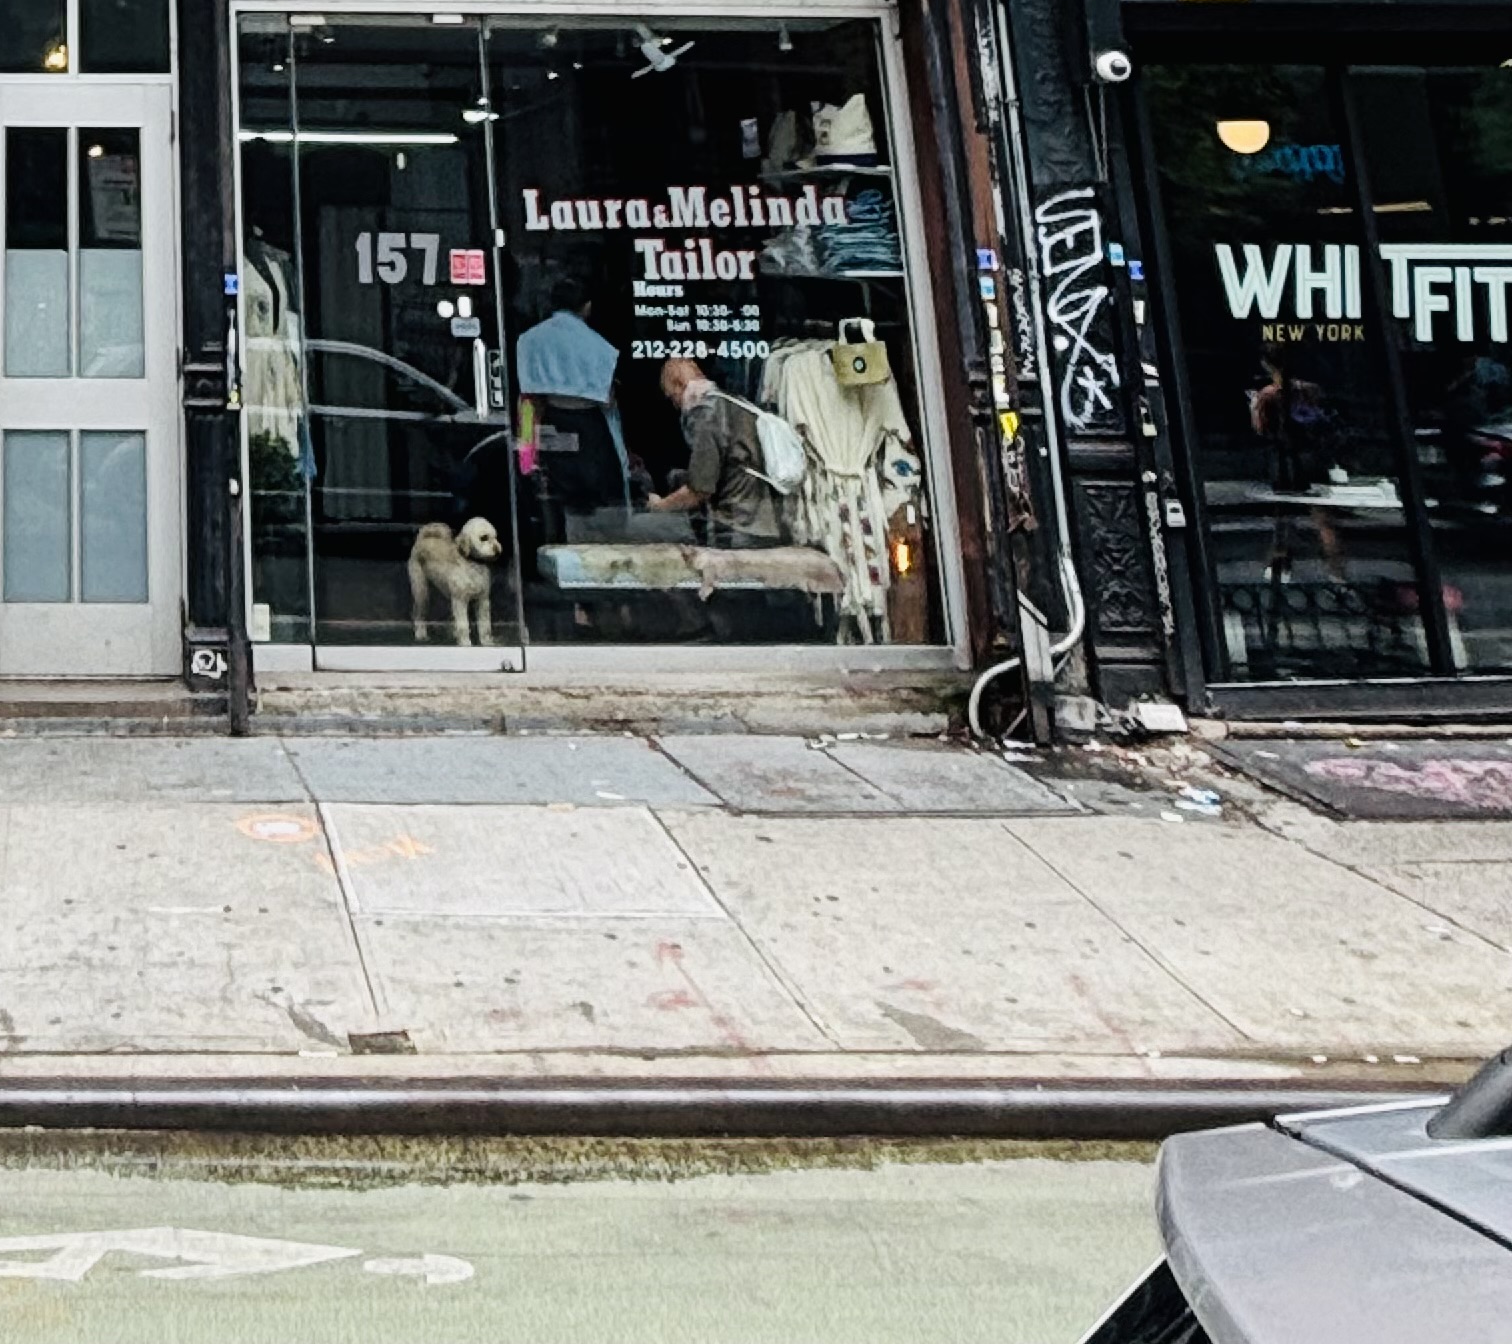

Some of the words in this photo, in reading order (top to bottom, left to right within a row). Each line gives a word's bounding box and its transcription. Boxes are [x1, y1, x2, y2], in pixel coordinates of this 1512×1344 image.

[355, 232, 440, 286] 157
[634, 238, 755, 281] Tailor
[632, 280, 685, 298] Hours
[666, 318, 691, 332] Sun
[1262, 324, 1305, 342] NEW
[1315, 324, 1365, 342] YORK
[631, 339, 770, 360] 212-228-4500
